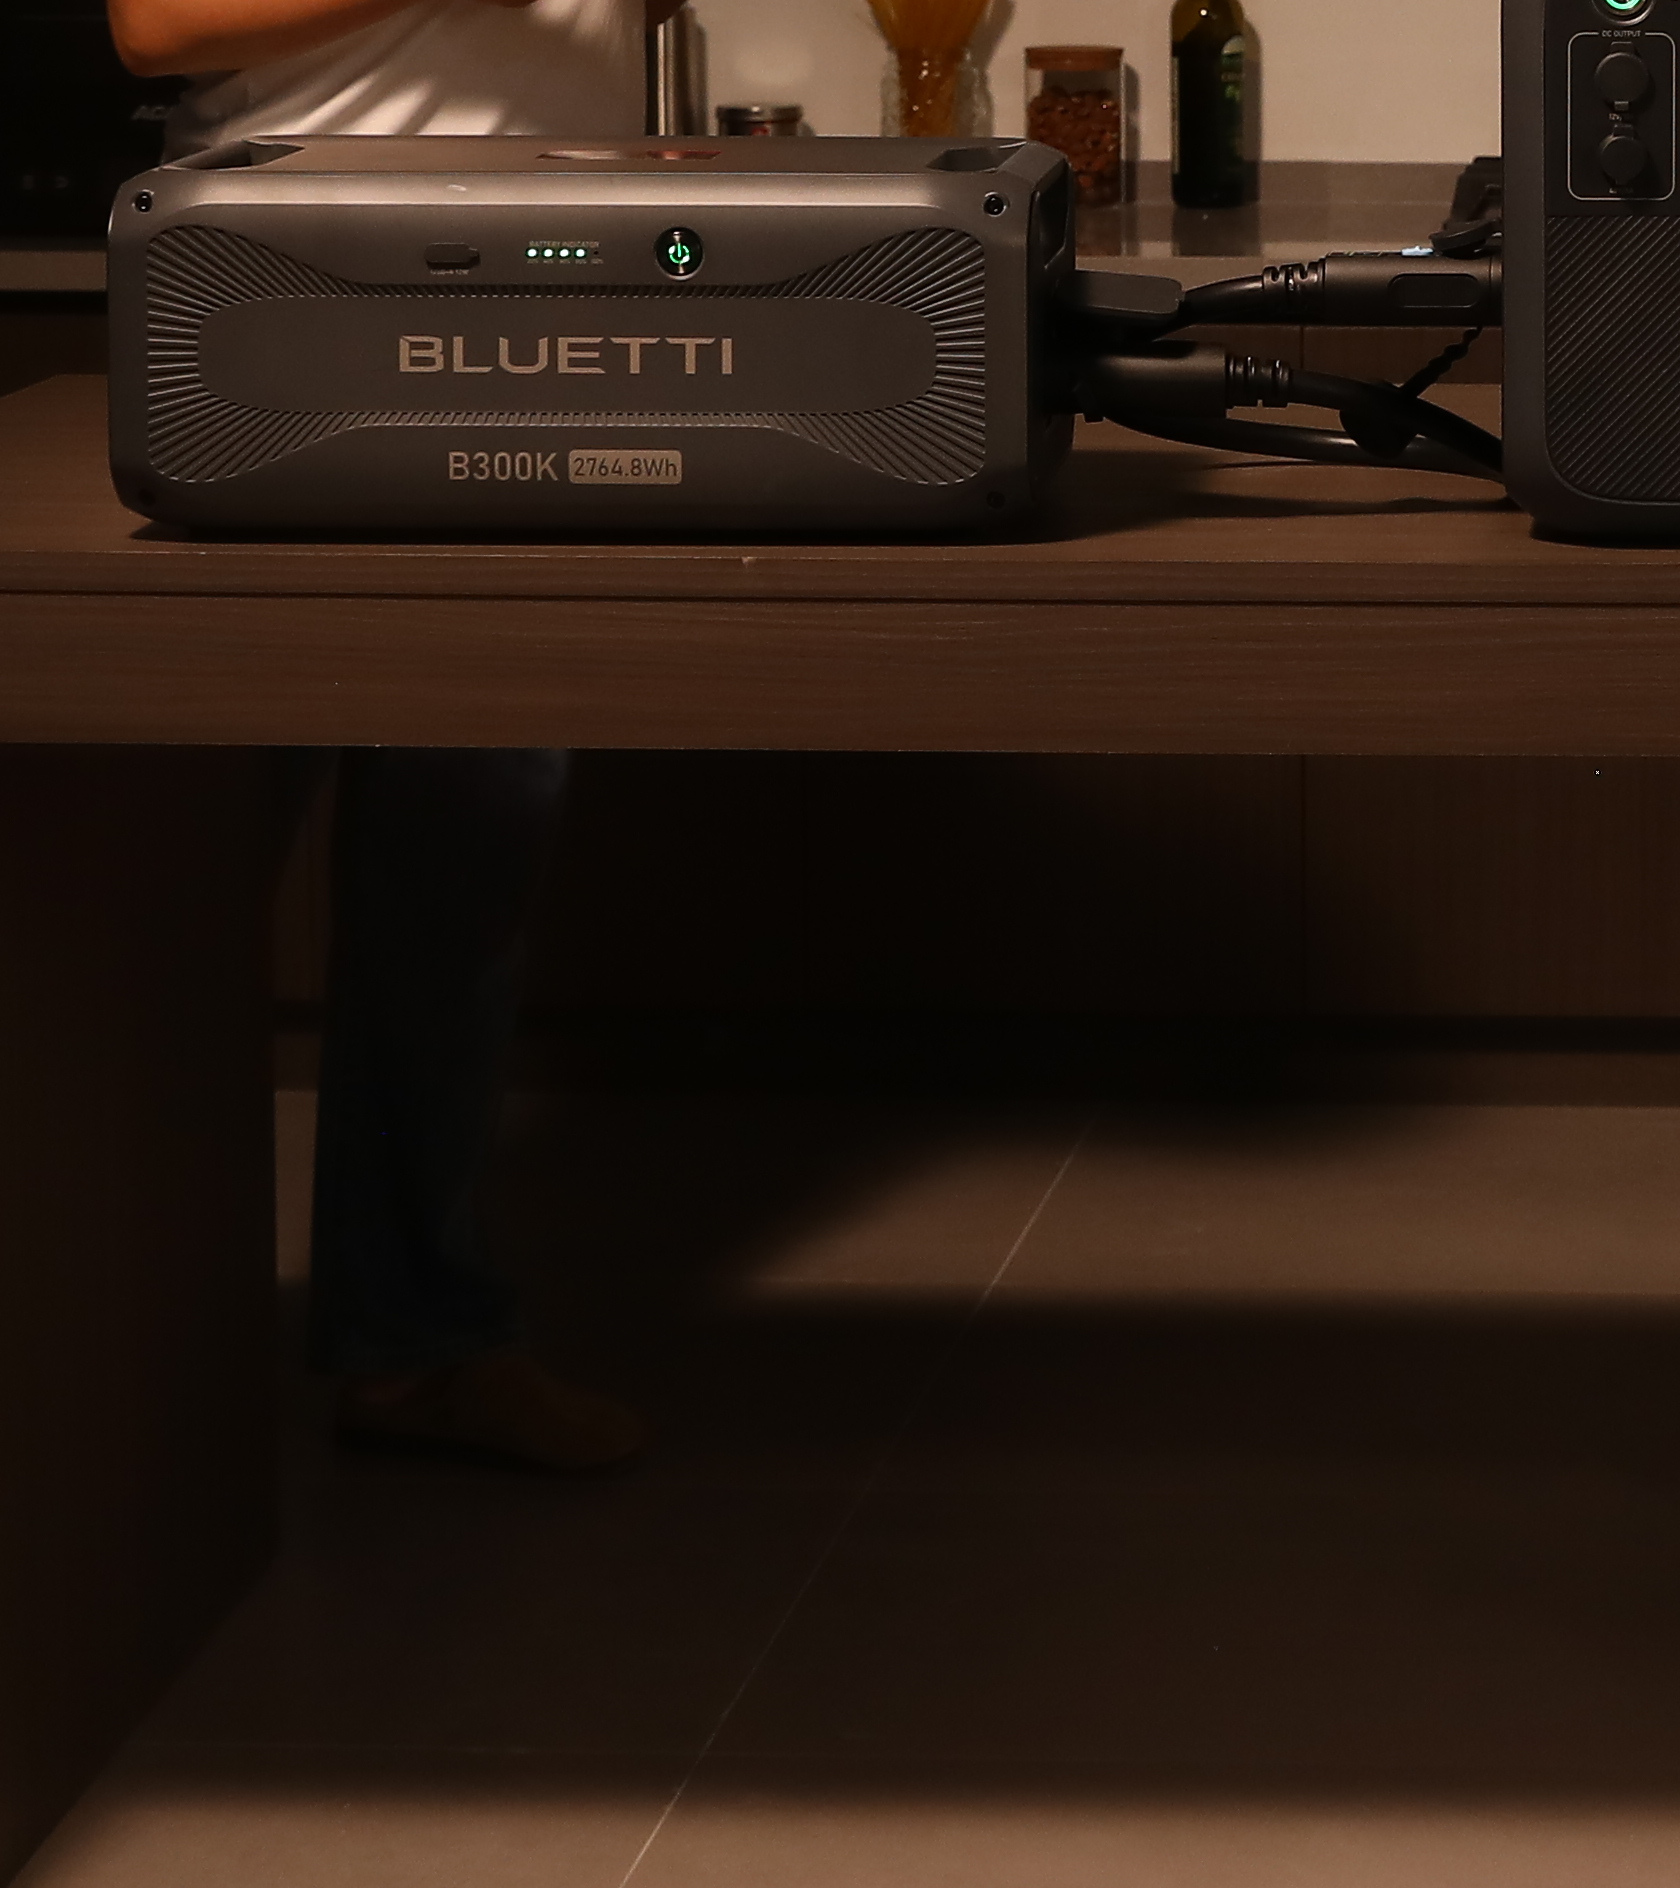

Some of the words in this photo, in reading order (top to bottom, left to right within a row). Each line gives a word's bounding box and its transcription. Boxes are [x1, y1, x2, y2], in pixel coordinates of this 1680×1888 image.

[399, 335, 733, 374] BLUETTI
[448, 451, 558, 481] B300K
[574, 457, 678, 477] 2764.8Wh
